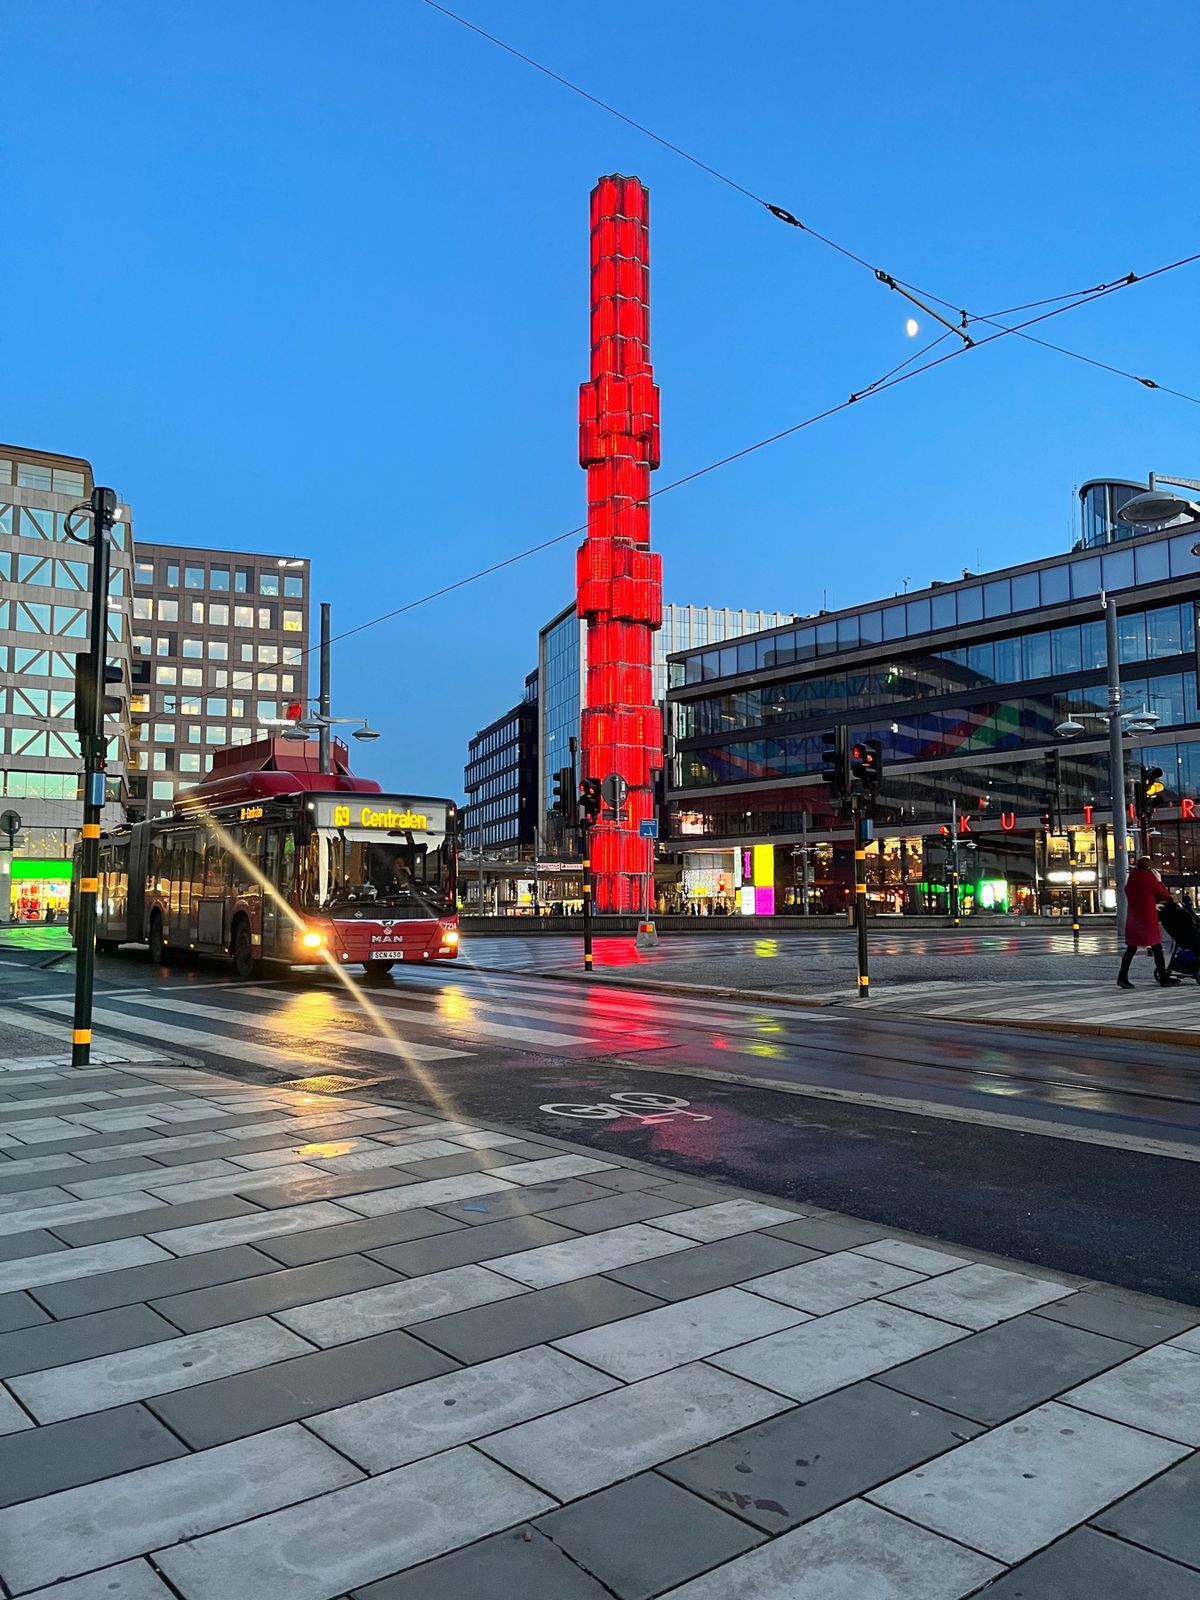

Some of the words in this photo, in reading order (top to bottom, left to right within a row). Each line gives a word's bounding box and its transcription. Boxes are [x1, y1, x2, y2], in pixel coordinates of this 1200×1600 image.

[334, 805, 350, 827] 69
[361, 807, 427, 829] Centralen
[371, 935, 403, 943] MAN
